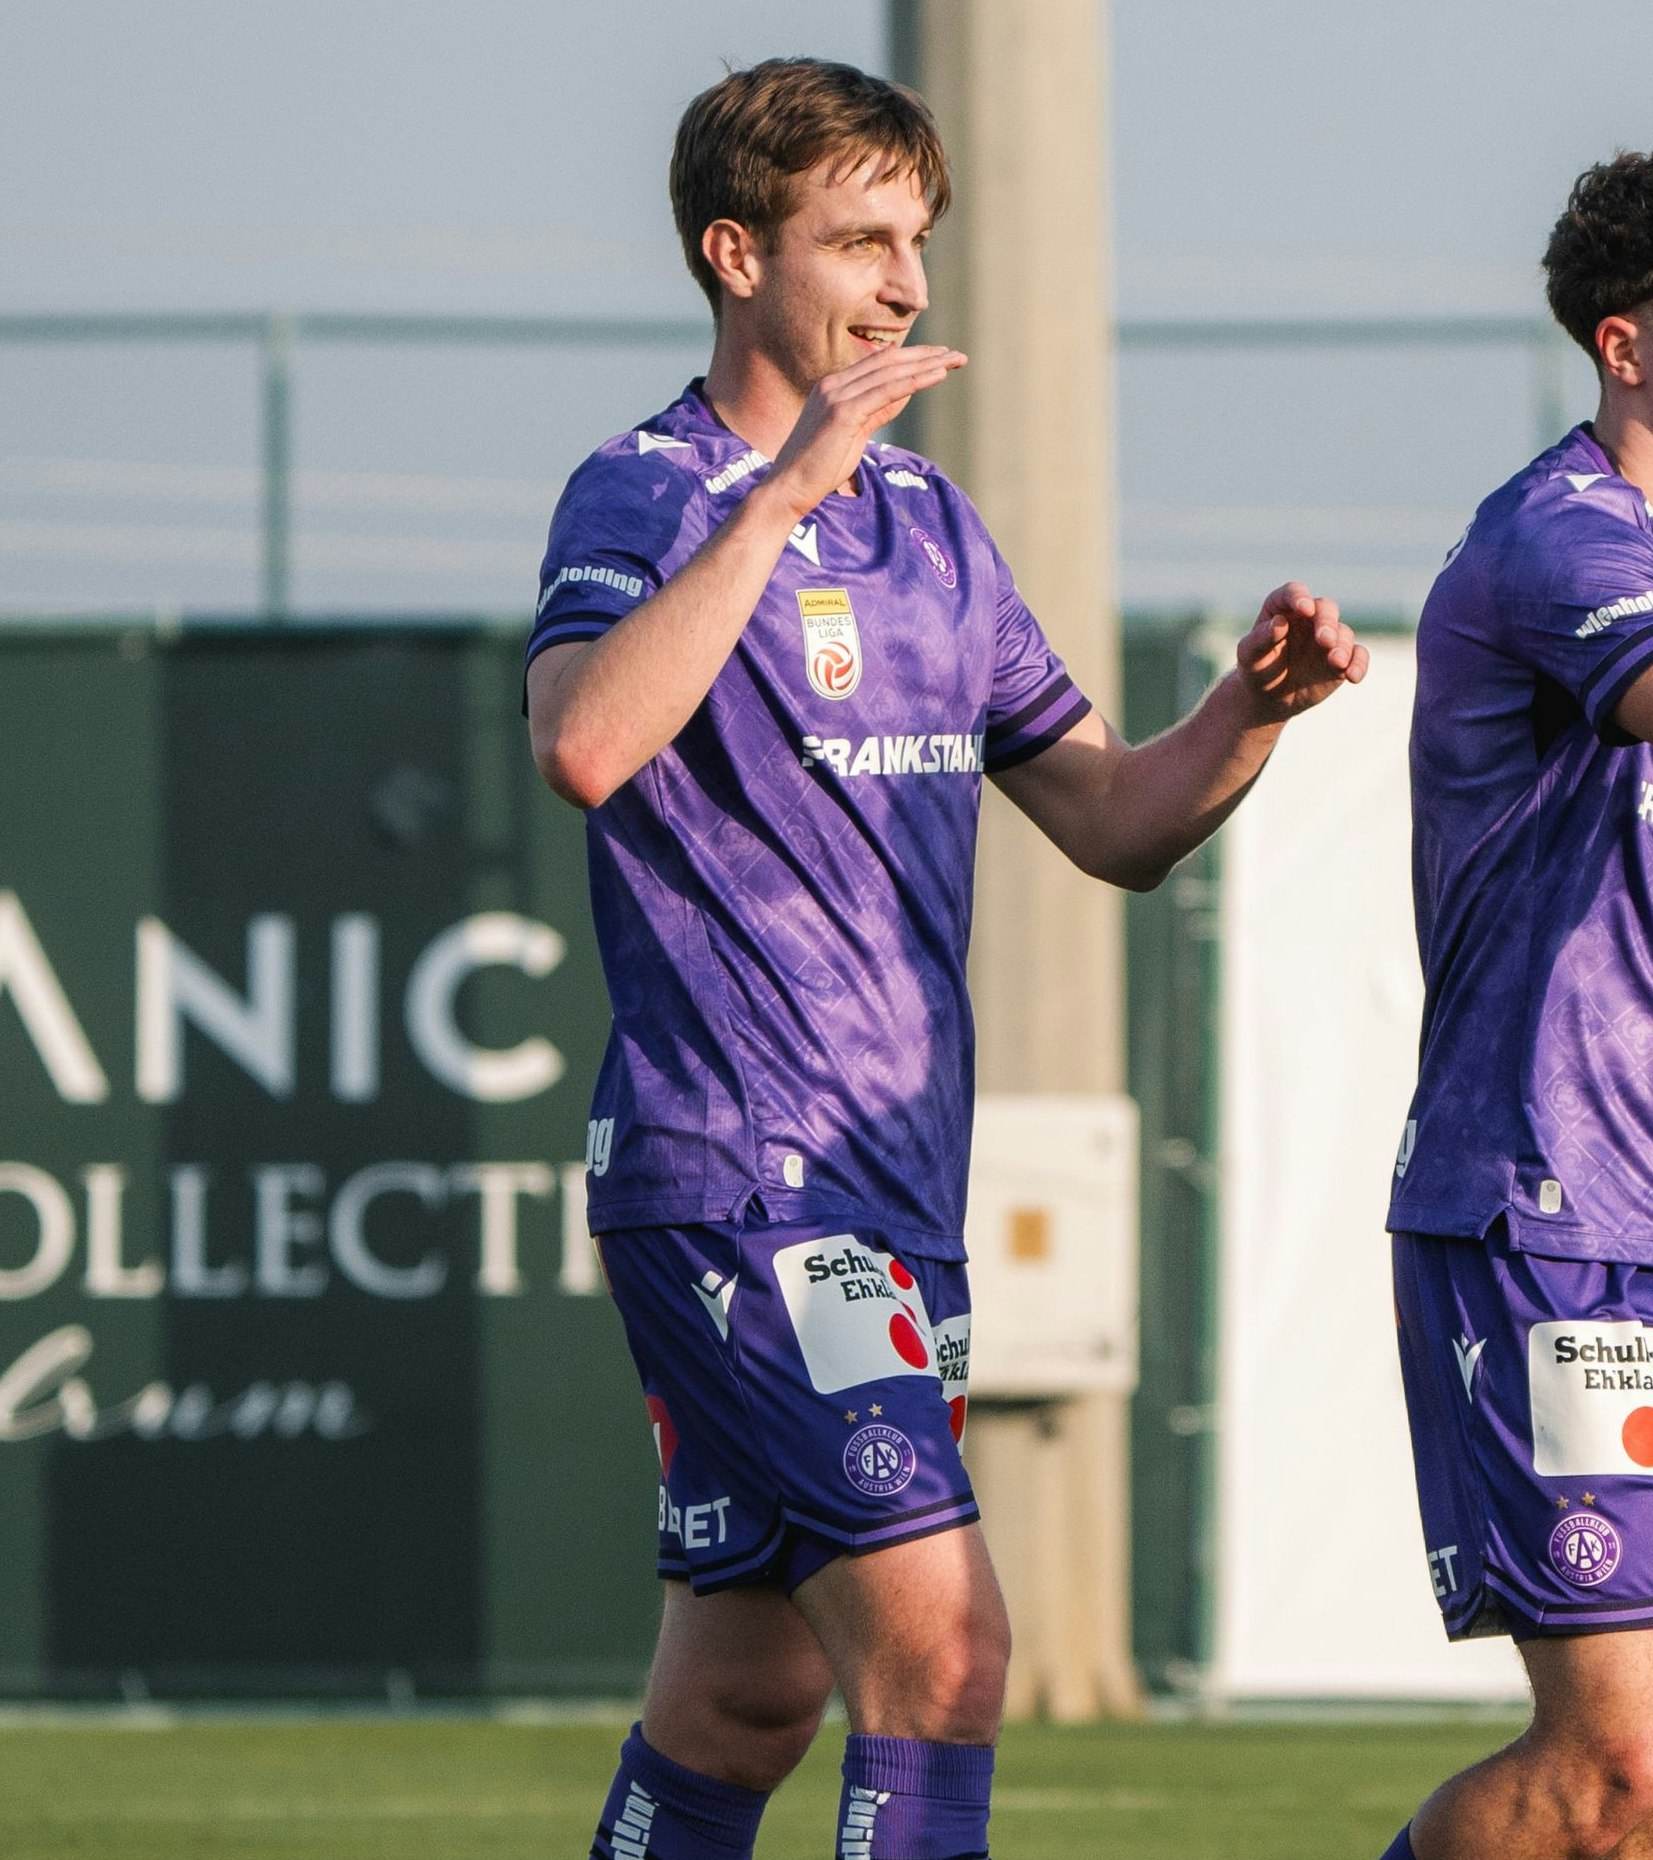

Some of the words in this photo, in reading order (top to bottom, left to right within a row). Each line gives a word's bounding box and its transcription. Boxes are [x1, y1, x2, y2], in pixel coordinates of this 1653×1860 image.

[804, 599, 846, 607] ADMIRAL
[807, 616, 851, 628] BUNDES
[819, 627, 844, 638] LIGA
[804, 1248, 886, 1283] Schu
